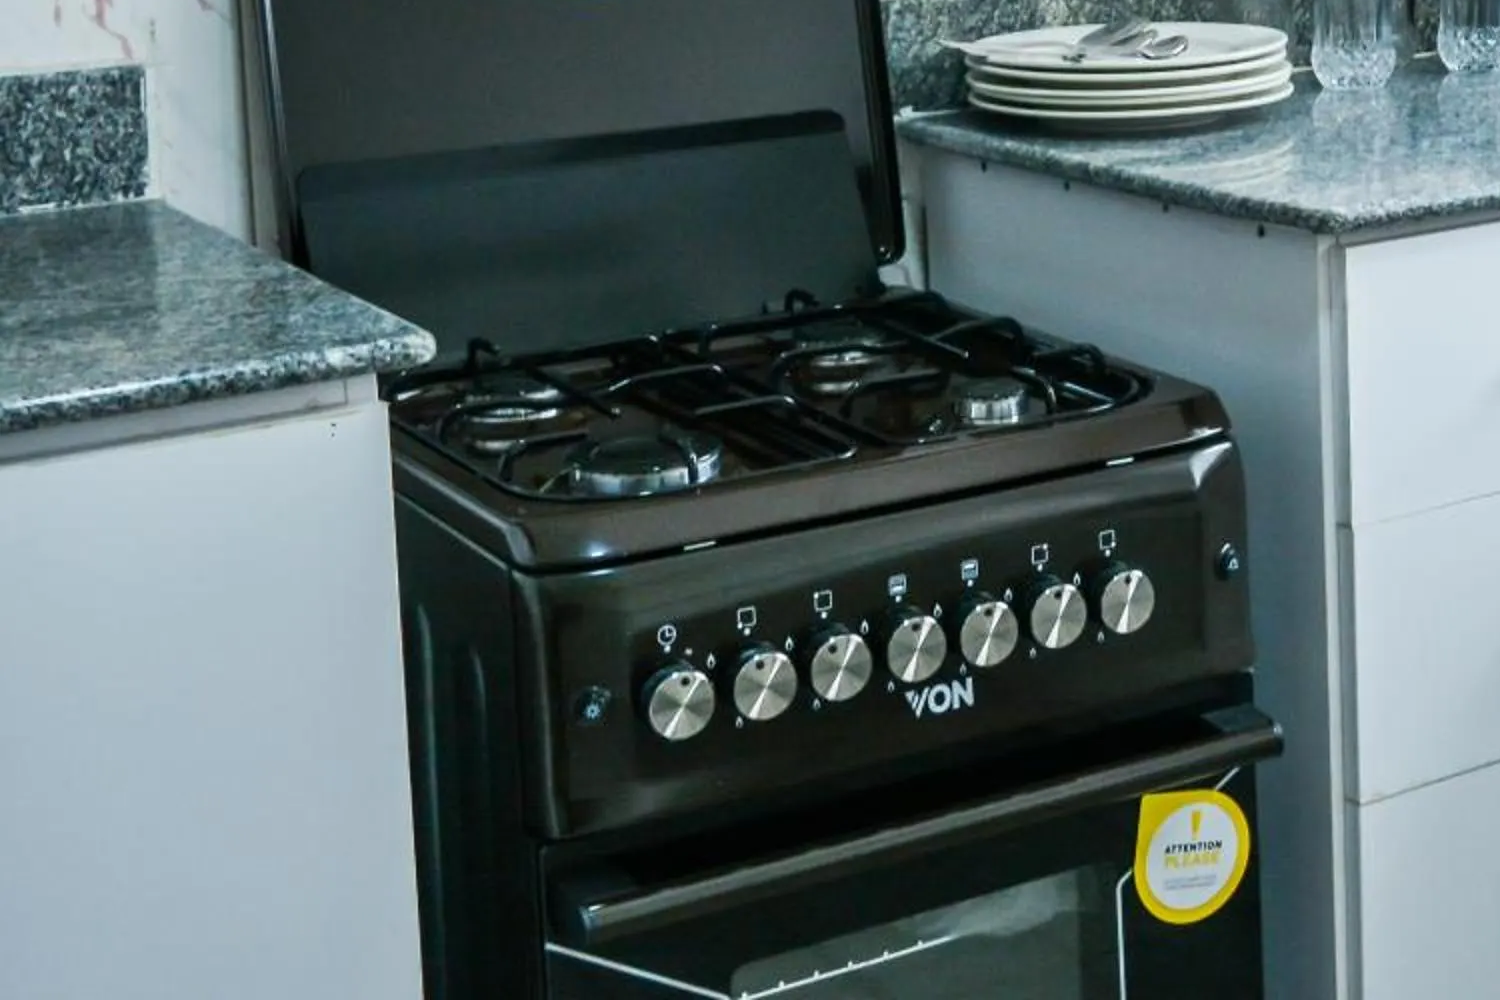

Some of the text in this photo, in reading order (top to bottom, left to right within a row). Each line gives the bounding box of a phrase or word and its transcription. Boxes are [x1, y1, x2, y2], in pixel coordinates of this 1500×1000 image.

[904, 676, 975, 719] VON
[1165, 840, 1222, 854] ATTENTION
[1165, 852, 1219, 870] PLEASE
